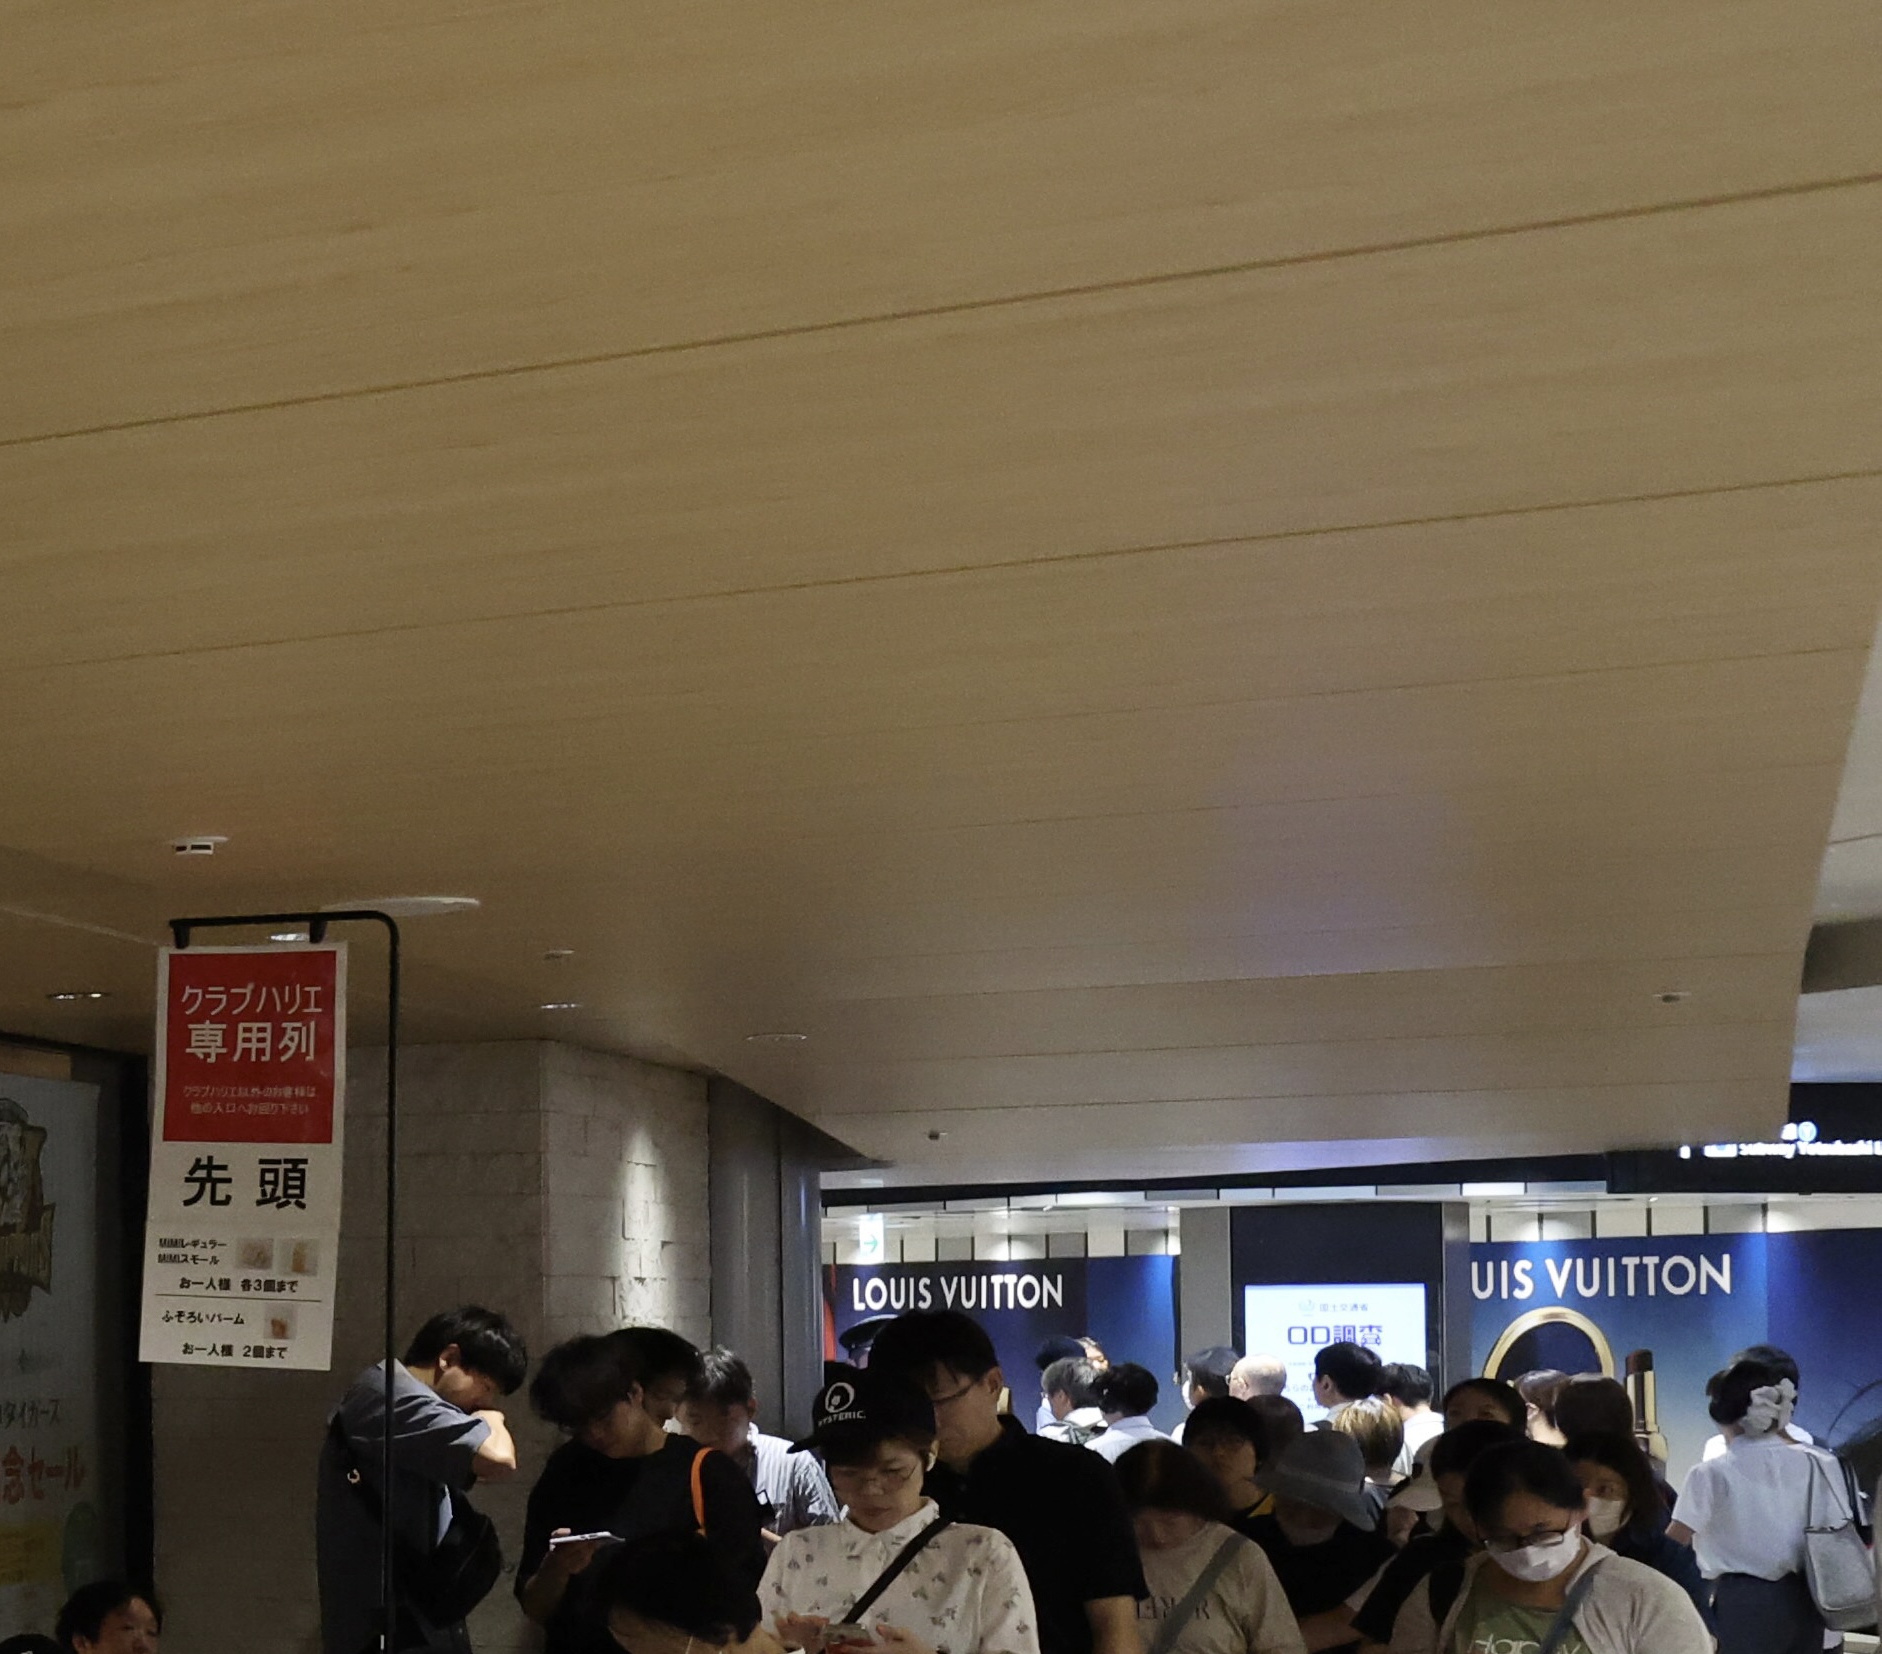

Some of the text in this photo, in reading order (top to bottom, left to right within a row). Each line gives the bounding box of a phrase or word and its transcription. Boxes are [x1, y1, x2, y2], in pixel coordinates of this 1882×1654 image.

[181, 983, 323, 1016] クラブハリエ
[185, 1019, 316, 1064] 専用列
[179, 1277, 231, 1292] お一人様
[852, 1273, 1063, 1311] LOUIS VUITTON
[1471, 1254, 1732, 1300] UIS VUITTON
[182, 1342, 234, 1358] お一人様
